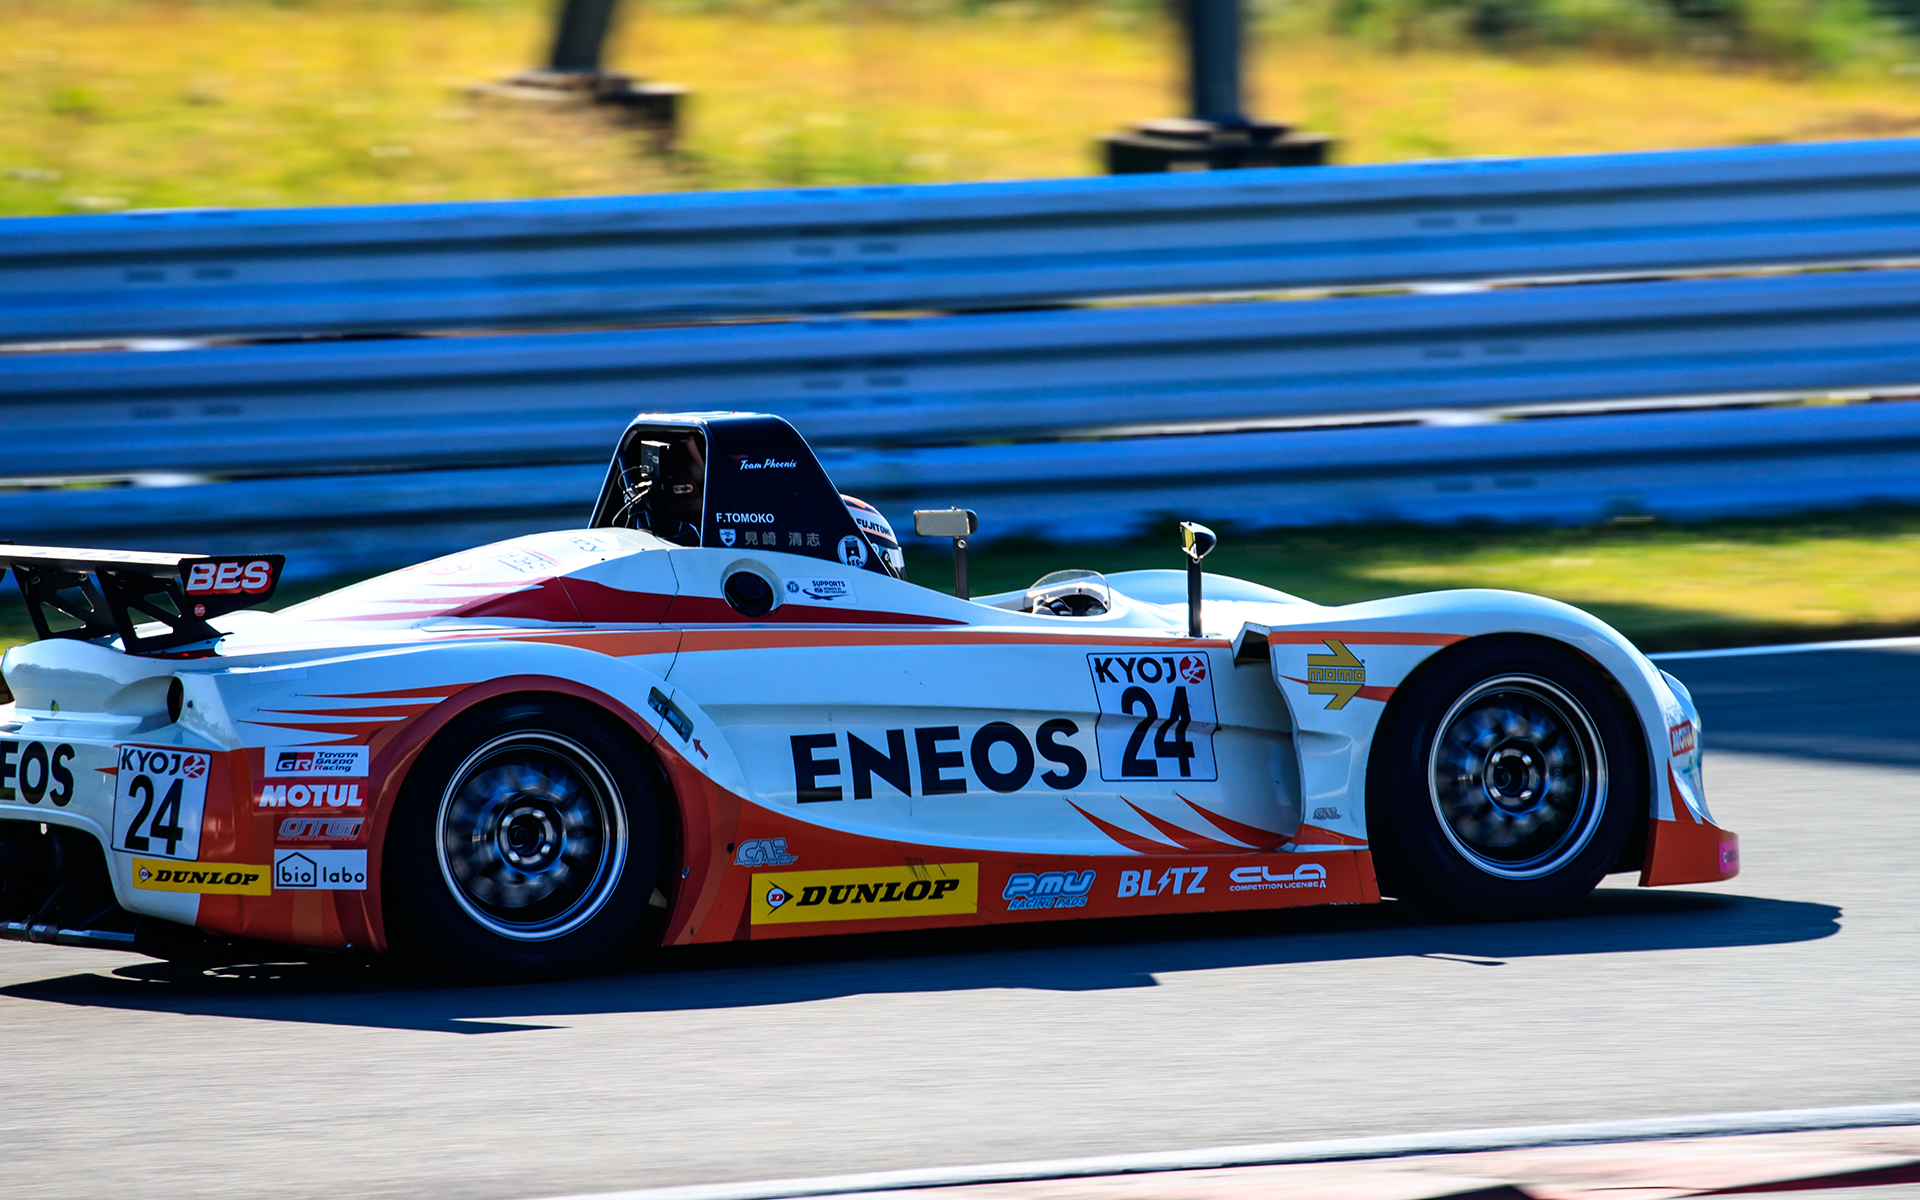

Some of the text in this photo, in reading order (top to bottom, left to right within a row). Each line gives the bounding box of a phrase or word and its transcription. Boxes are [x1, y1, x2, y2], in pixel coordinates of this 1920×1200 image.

[740, 458, 797, 470] Team Phoenix
[716, 512, 775, 523] F.TOMOKO
[186, 561, 272, 594] BBS
[1308, 668, 1366, 682] momo
[1121, 685, 1195, 777] 24
[277, 758, 313, 771] GR
[314, 764, 351, 772] Racing
[789, 718, 1088, 804] ENEOS
[258, 784, 363, 807] MOTUL
[124, 774, 184, 855] 24
[154, 869, 259, 885] DUNLOP
[282, 866, 365, 883] bio labo
[1117, 866, 1209, 898] BLITZ
[796, 879, 960, 907] DUNLOP
[1229, 883, 1283, 892] COMPETITION
[1283, 881, 1319, 889] LICENSE
[1007, 896, 1088, 910] RACING PADS
